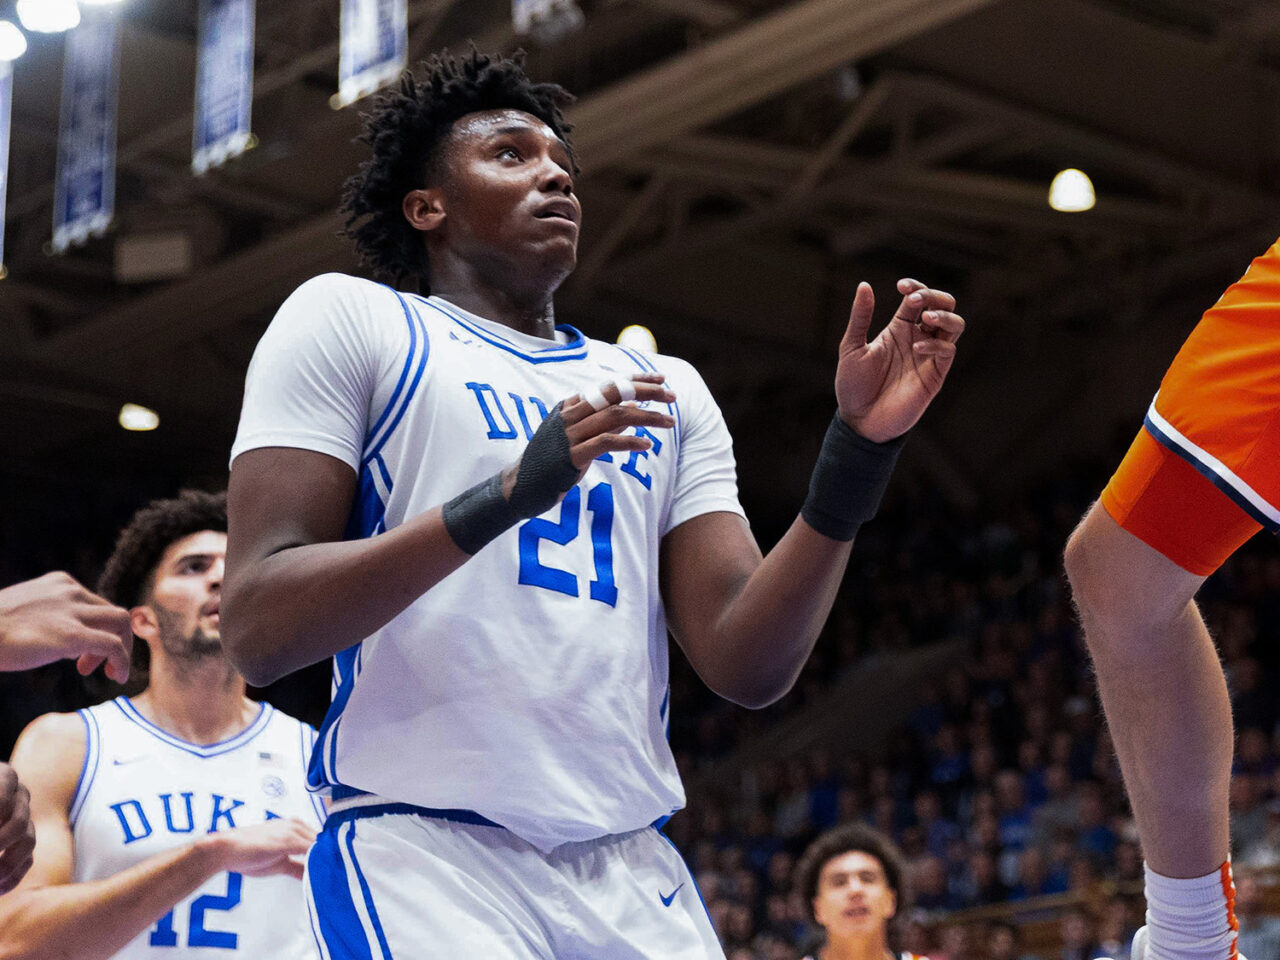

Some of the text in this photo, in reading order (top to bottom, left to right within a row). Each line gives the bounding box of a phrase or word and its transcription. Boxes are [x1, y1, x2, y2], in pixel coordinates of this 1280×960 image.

[465, 381, 663, 491] DUE
[518, 482, 618, 608] 21
[109, 791, 284, 845] DUK
